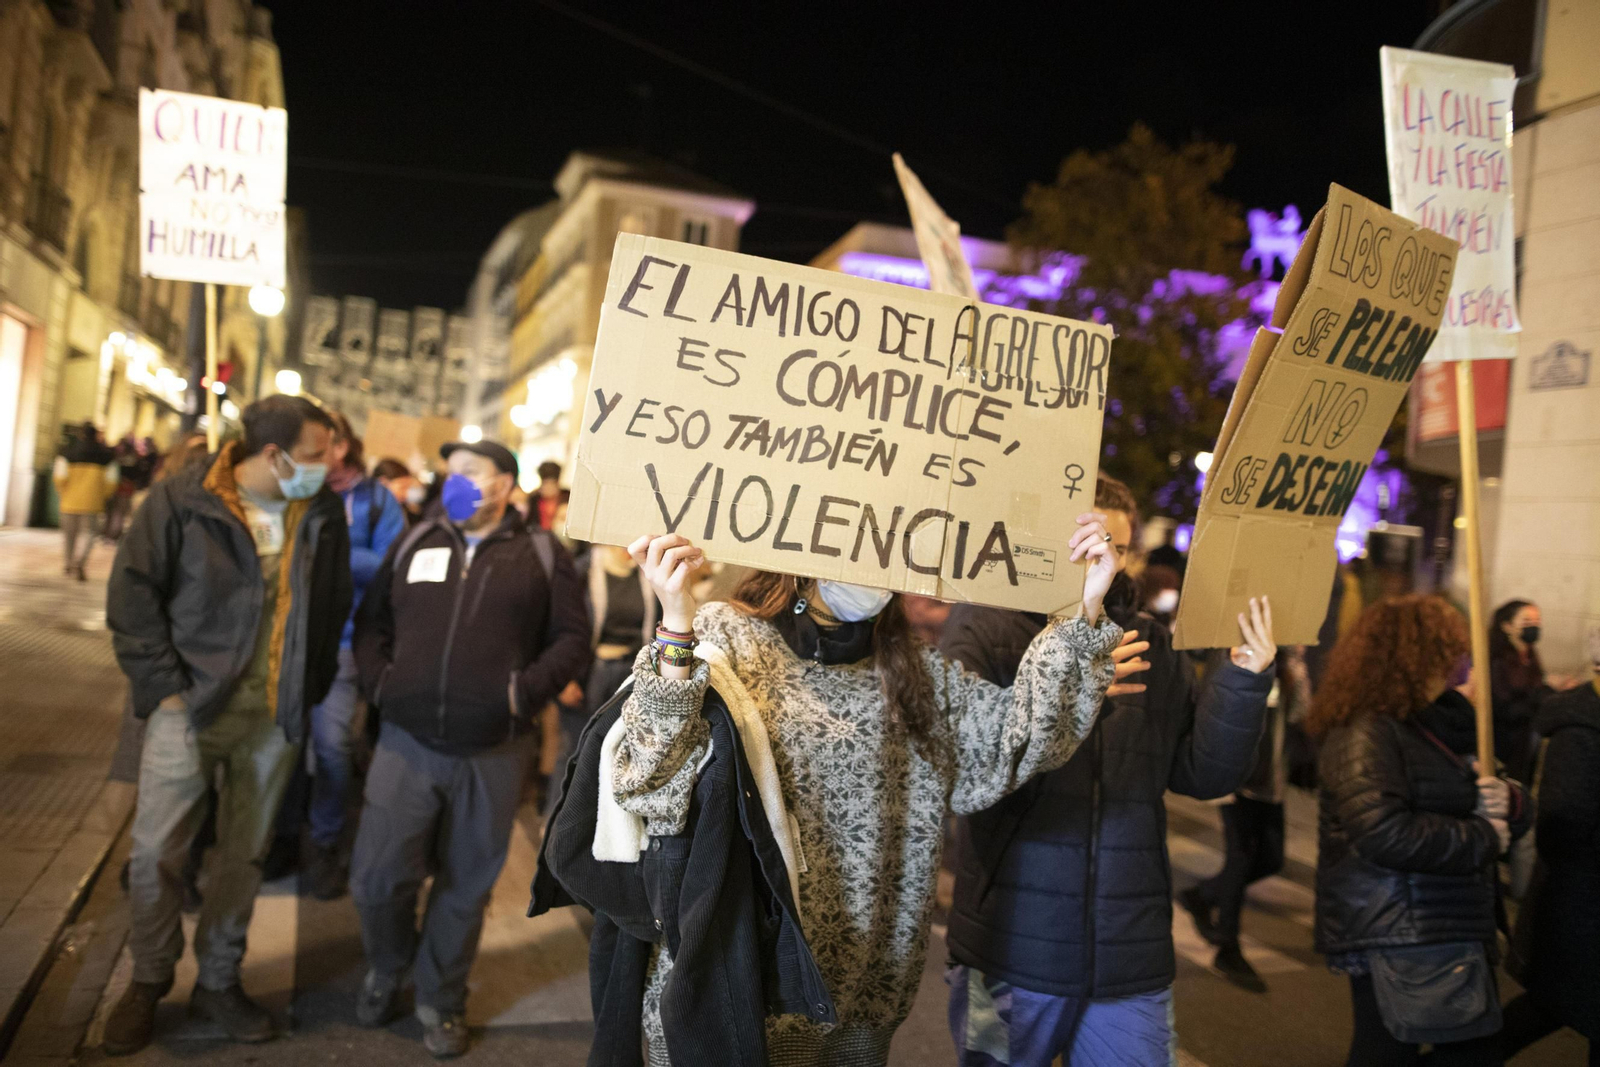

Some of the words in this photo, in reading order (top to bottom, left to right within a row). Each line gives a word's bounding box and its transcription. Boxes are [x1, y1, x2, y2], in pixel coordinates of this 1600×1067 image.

[1404, 82, 1436, 135] LA
[1438, 88, 1507, 143] CALLE
[173, 160, 249, 199] AMA
[1427, 144, 1452, 187] LA
[147, 217, 261, 264] HUMILLA
[1328, 203, 1393, 289] LOS
[1389, 235, 1453, 317] QUE
[617, 254, 697, 323] EL
[709, 272, 861, 343] AMIGO
[878, 304, 947, 370] DEL
[947, 304, 1110, 400] AGRESOR
[1292, 306, 1341, 358] SE
[1324, 297, 1439, 384] PELEAN
[1443, 284, 1514, 329] UESTRAS
[676, 336, 747, 388] ES
[775, 347, 1021, 457] CÓMPLICE,
[1282, 379, 1369, 450] NO
[588, 387, 623, 434] Y
[625, 397, 710, 450] ESO
[722, 412, 900, 477] TAMBIÉN
[922, 451, 986, 488] ES
[1220, 455, 1268, 506] SE
[1254, 451, 1370, 517] DESEAN
[644, 461, 1020, 587] VIOLENCIA
[1021, 547, 1030, 555] DS
[1029, 548, 1046, 558] Smith
